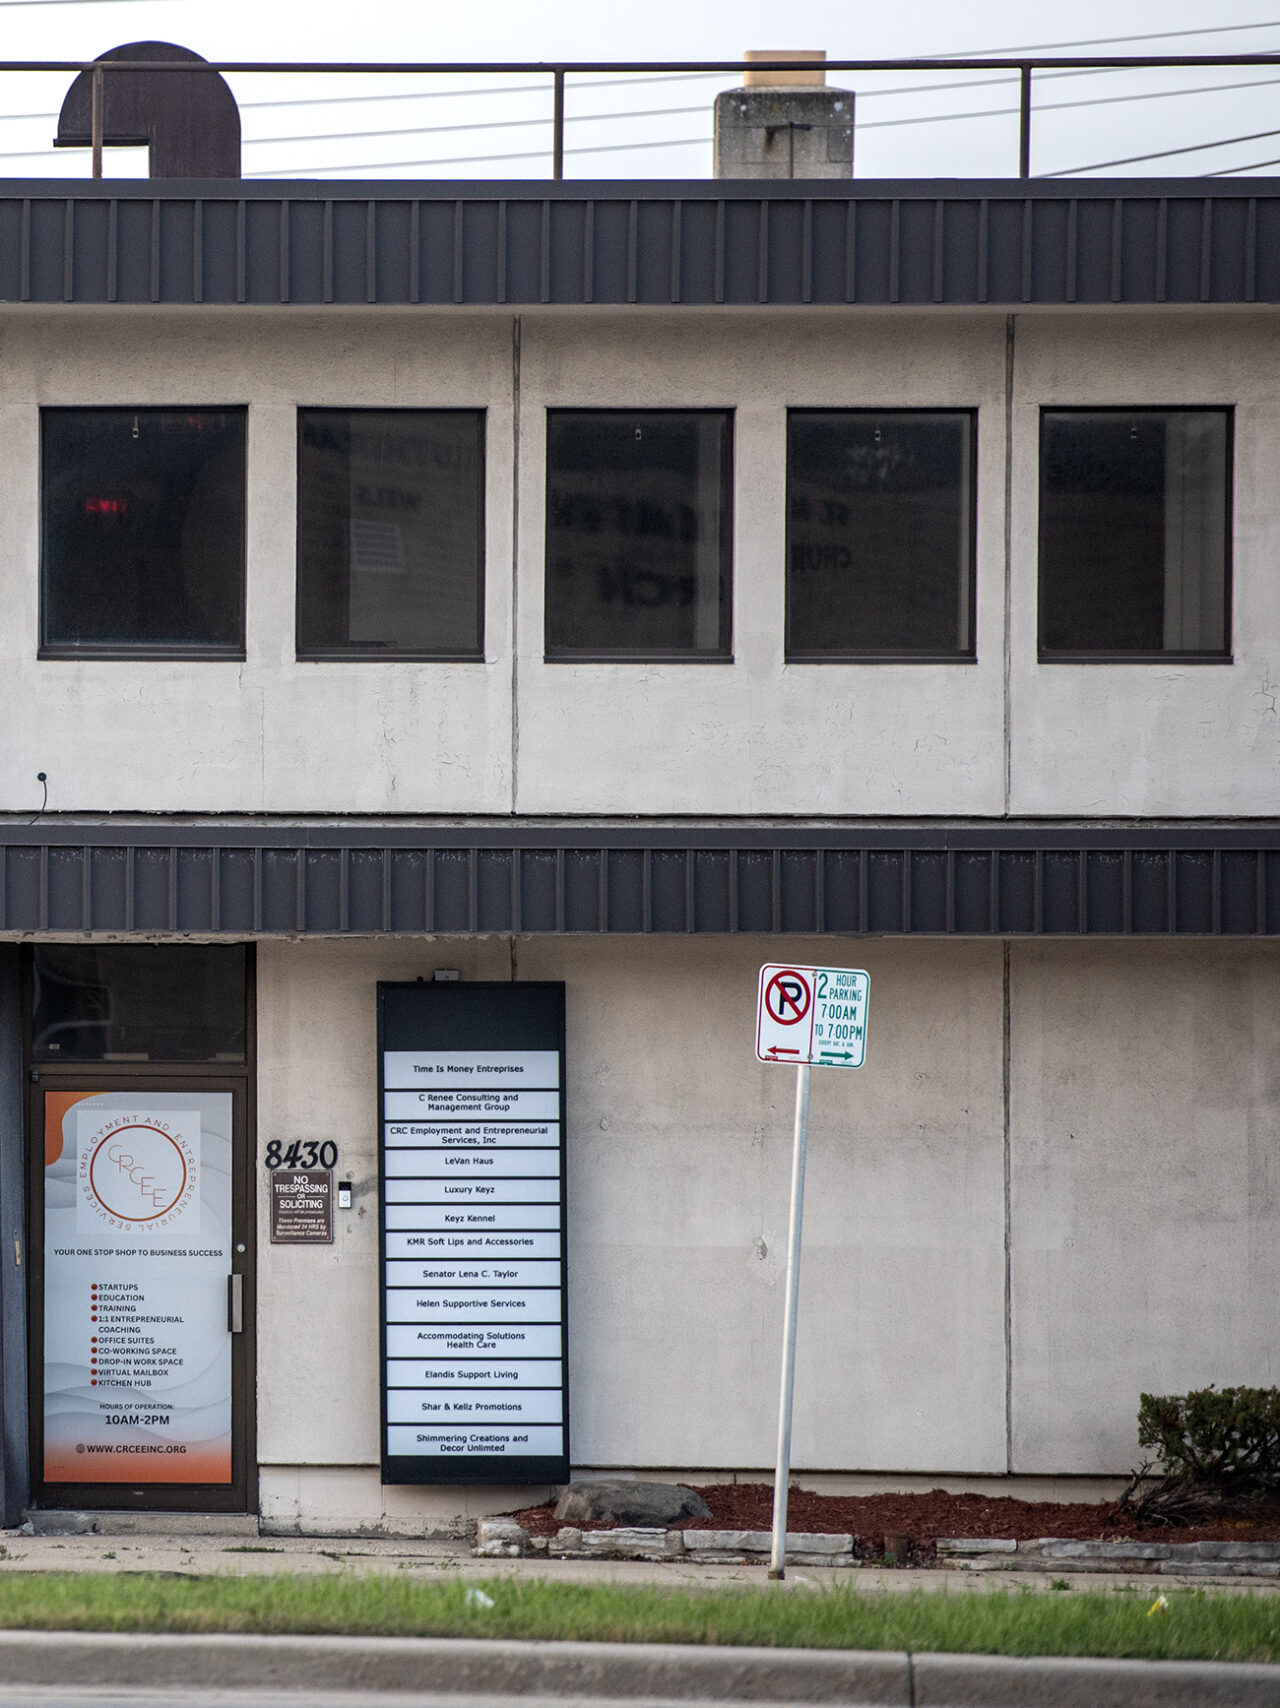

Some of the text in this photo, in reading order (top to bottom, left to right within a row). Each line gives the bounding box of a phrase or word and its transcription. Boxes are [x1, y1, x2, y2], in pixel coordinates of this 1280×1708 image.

[818, 973, 857, 999] 2 HOUR
[779, 981, 803, 1015] P
[829, 988, 863, 1002] PARKING
[822, 1004, 857, 1021] 7:00AM
[815, 1024, 863, 1041] TO 7:00PM
[447, 1066, 474, 1074] Money
[477, 1065, 524, 1074] Entreprises
[456, 1094, 500, 1103] Consulting
[428, 1103, 510, 1112] Management Group
[144, 1116, 170, 1132] AND
[410, 1127, 462, 1136] Employment
[484, 1127, 548, 1135] Entrepreneurial
[442, 1136, 496, 1145] Services, Inc
[80, 1115, 139, 1178] EMPLOYMENT
[265, 1140, 338, 1169] 8430
[108, 1144, 168, 1207] CRCEE
[138, 1133, 196, 1232] ENTREPRENEURIAL
[294, 1176, 309, 1185] NO
[274, 1184, 329, 1193] TRESPASSING
[445, 1186, 495, 1194] Luxury Keyz
[83, 1186, 131, 1232] SERVICES
[280, 1200, 323, 1209] SOLICITING
[445, 1215, 464, 1223] Keyz
[448, 1238, 464, 1247] Lips
[423, 1270, 456, 1278] Senator
[493, 1270, 518, 1279] Taylor
[443, 1300, 488, 1309] Supportive
[417, 1332, 525, 1342] Accommodating Solutions
[476, 1340, 496, 1348] Care
[98, 1369, 131, 1377] VIRTUAL
[458, 1371, 491, 1379] Support
[494, 1371, 518, 1380] Living
[444, 1403, 451, 1411] &
[476, 1403, 522, 1411] Promotions
[106, 1415, 169, 1425] 10AM-2PM
[417, 1434, 467, 1444] Shimmering
[470, 1434, 510, 1442] Creations
[87, 1445, 186, 1454] WWW.CRCEEINC.ORG
[440, 1443, 465, 1452] Decor
